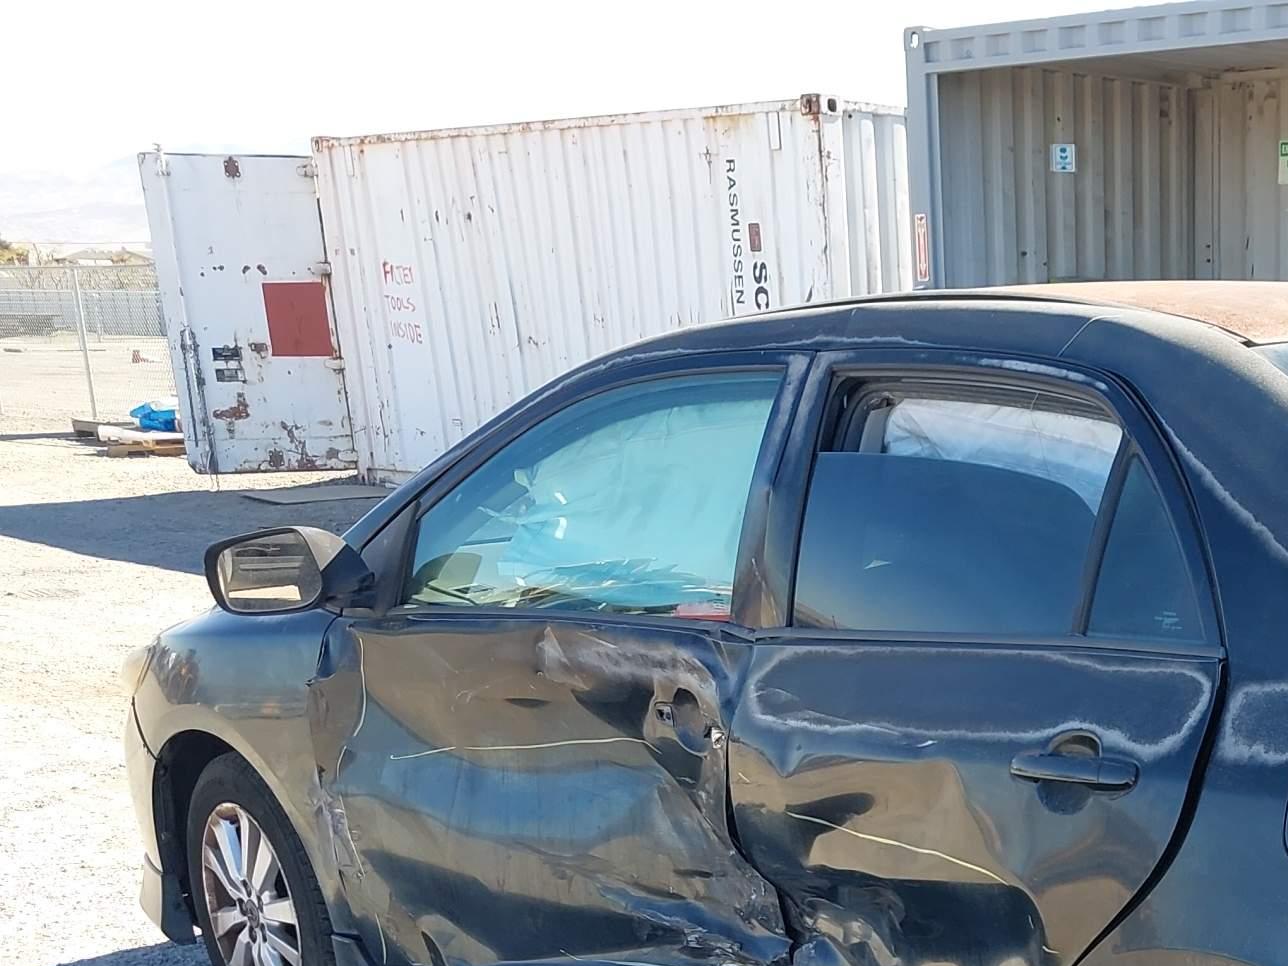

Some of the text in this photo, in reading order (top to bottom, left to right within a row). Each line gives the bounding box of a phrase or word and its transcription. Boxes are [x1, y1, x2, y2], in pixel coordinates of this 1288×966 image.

[725, 159, 745, 304] RASMUSSEN
[384, 294, 416, 313] TOOLS
[390, 320, 423, 344] INSIDE
